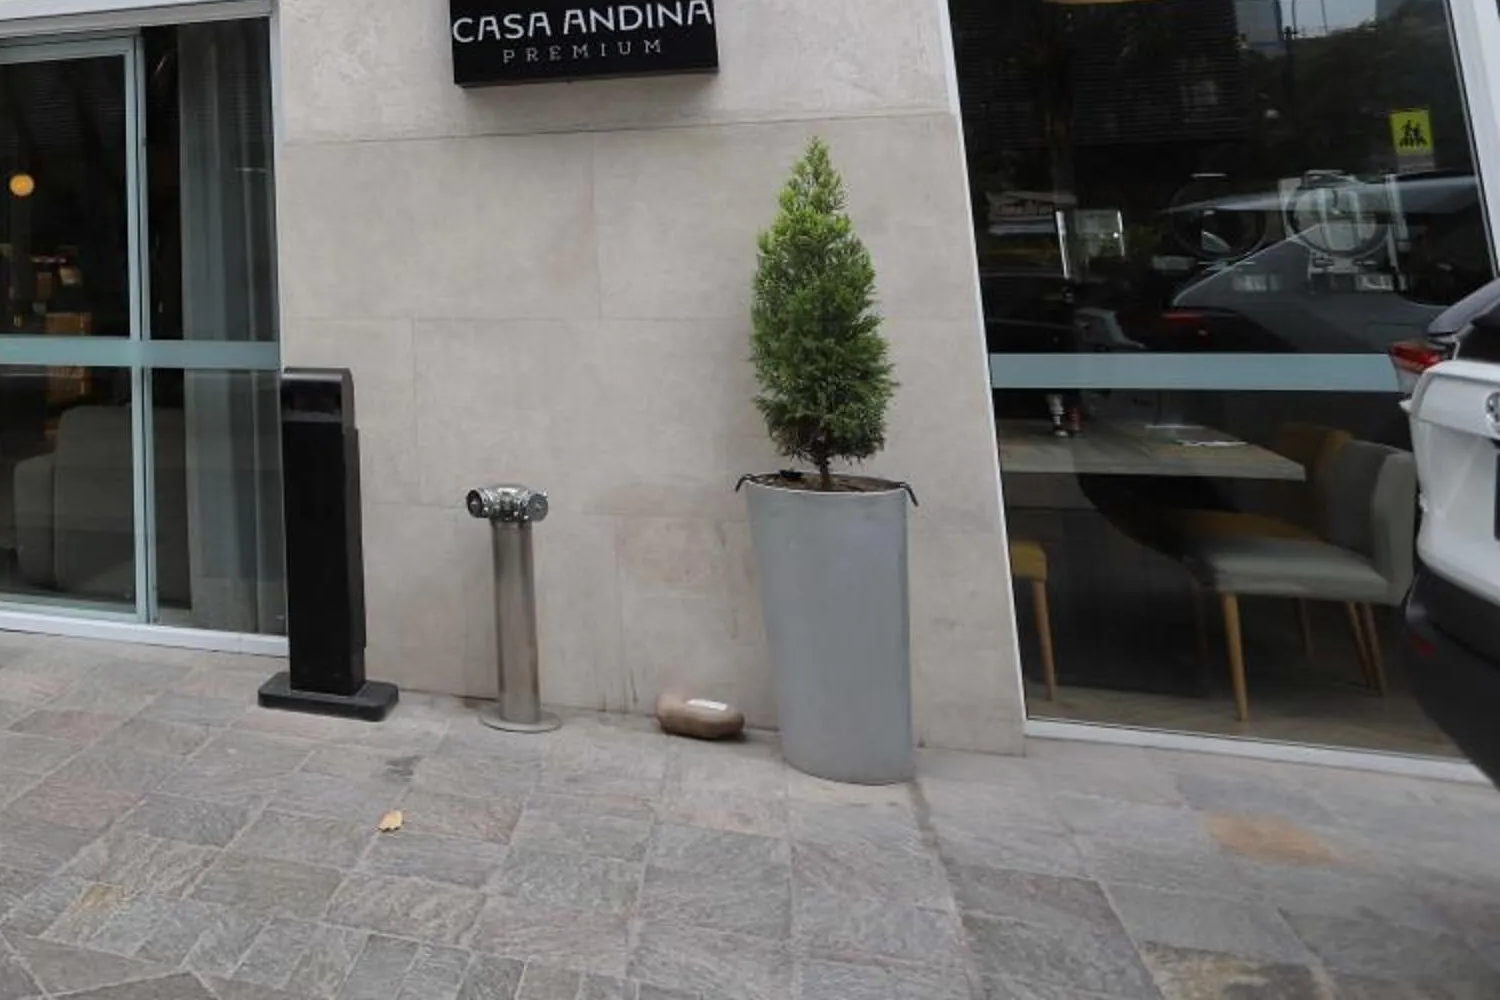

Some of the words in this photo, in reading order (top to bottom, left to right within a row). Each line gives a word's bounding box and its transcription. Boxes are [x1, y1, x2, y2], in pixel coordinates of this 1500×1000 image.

[452, 10, 551, 43] CASA
[563, 0, 713, 34] ANDINA
[503, 39, 661, 63] PREMIUM
